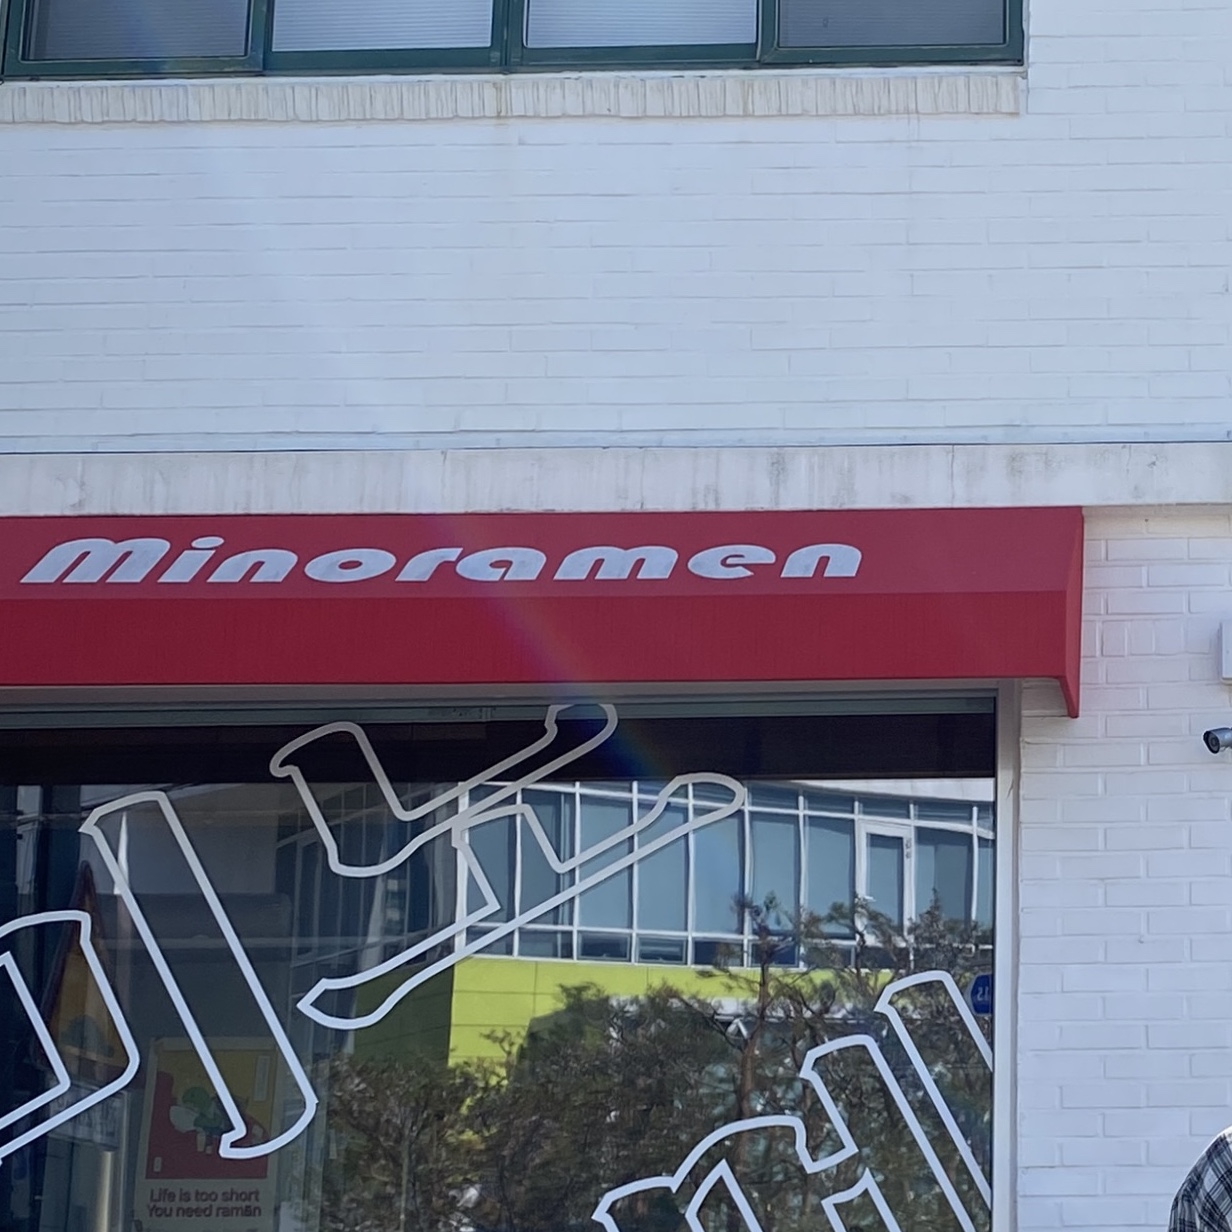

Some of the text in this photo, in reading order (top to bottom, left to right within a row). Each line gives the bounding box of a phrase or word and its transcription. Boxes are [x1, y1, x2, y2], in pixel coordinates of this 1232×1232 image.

[20, 536, 863, 584] Minoramen
[150, 1187, 260, 1202] Life is too short
[148, 1204, 173, 1217] You
[176, 1204, 213, 1217] need
